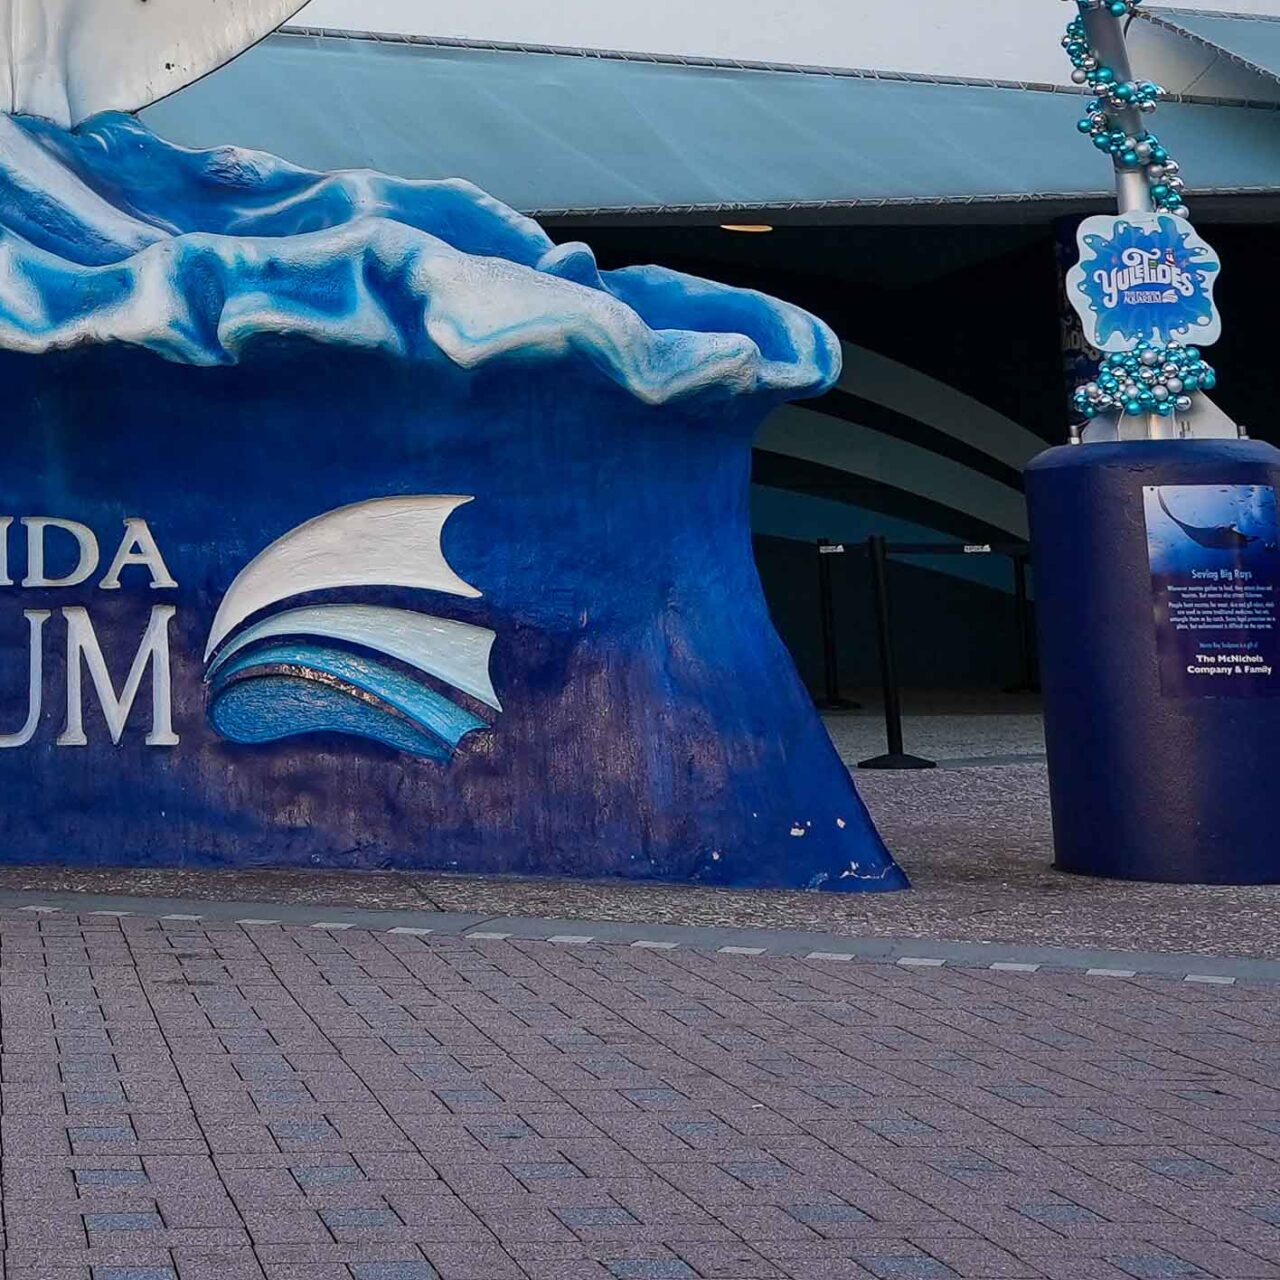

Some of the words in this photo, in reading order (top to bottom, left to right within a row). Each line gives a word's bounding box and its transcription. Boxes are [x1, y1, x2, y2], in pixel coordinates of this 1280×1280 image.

[1191, 569, 1218, 580] Saving
[1220, 569, 1233, 580] Big
[1234, 569, 1252, 580] Rays
[1196, 654, 1216, 663] The
[1217, 654, 1264, 663] McNichols
[1186, 665, 1233, 675] Company
[1234, 665, 1242, 674] &
[1244, 665, 1272, 675] Family
